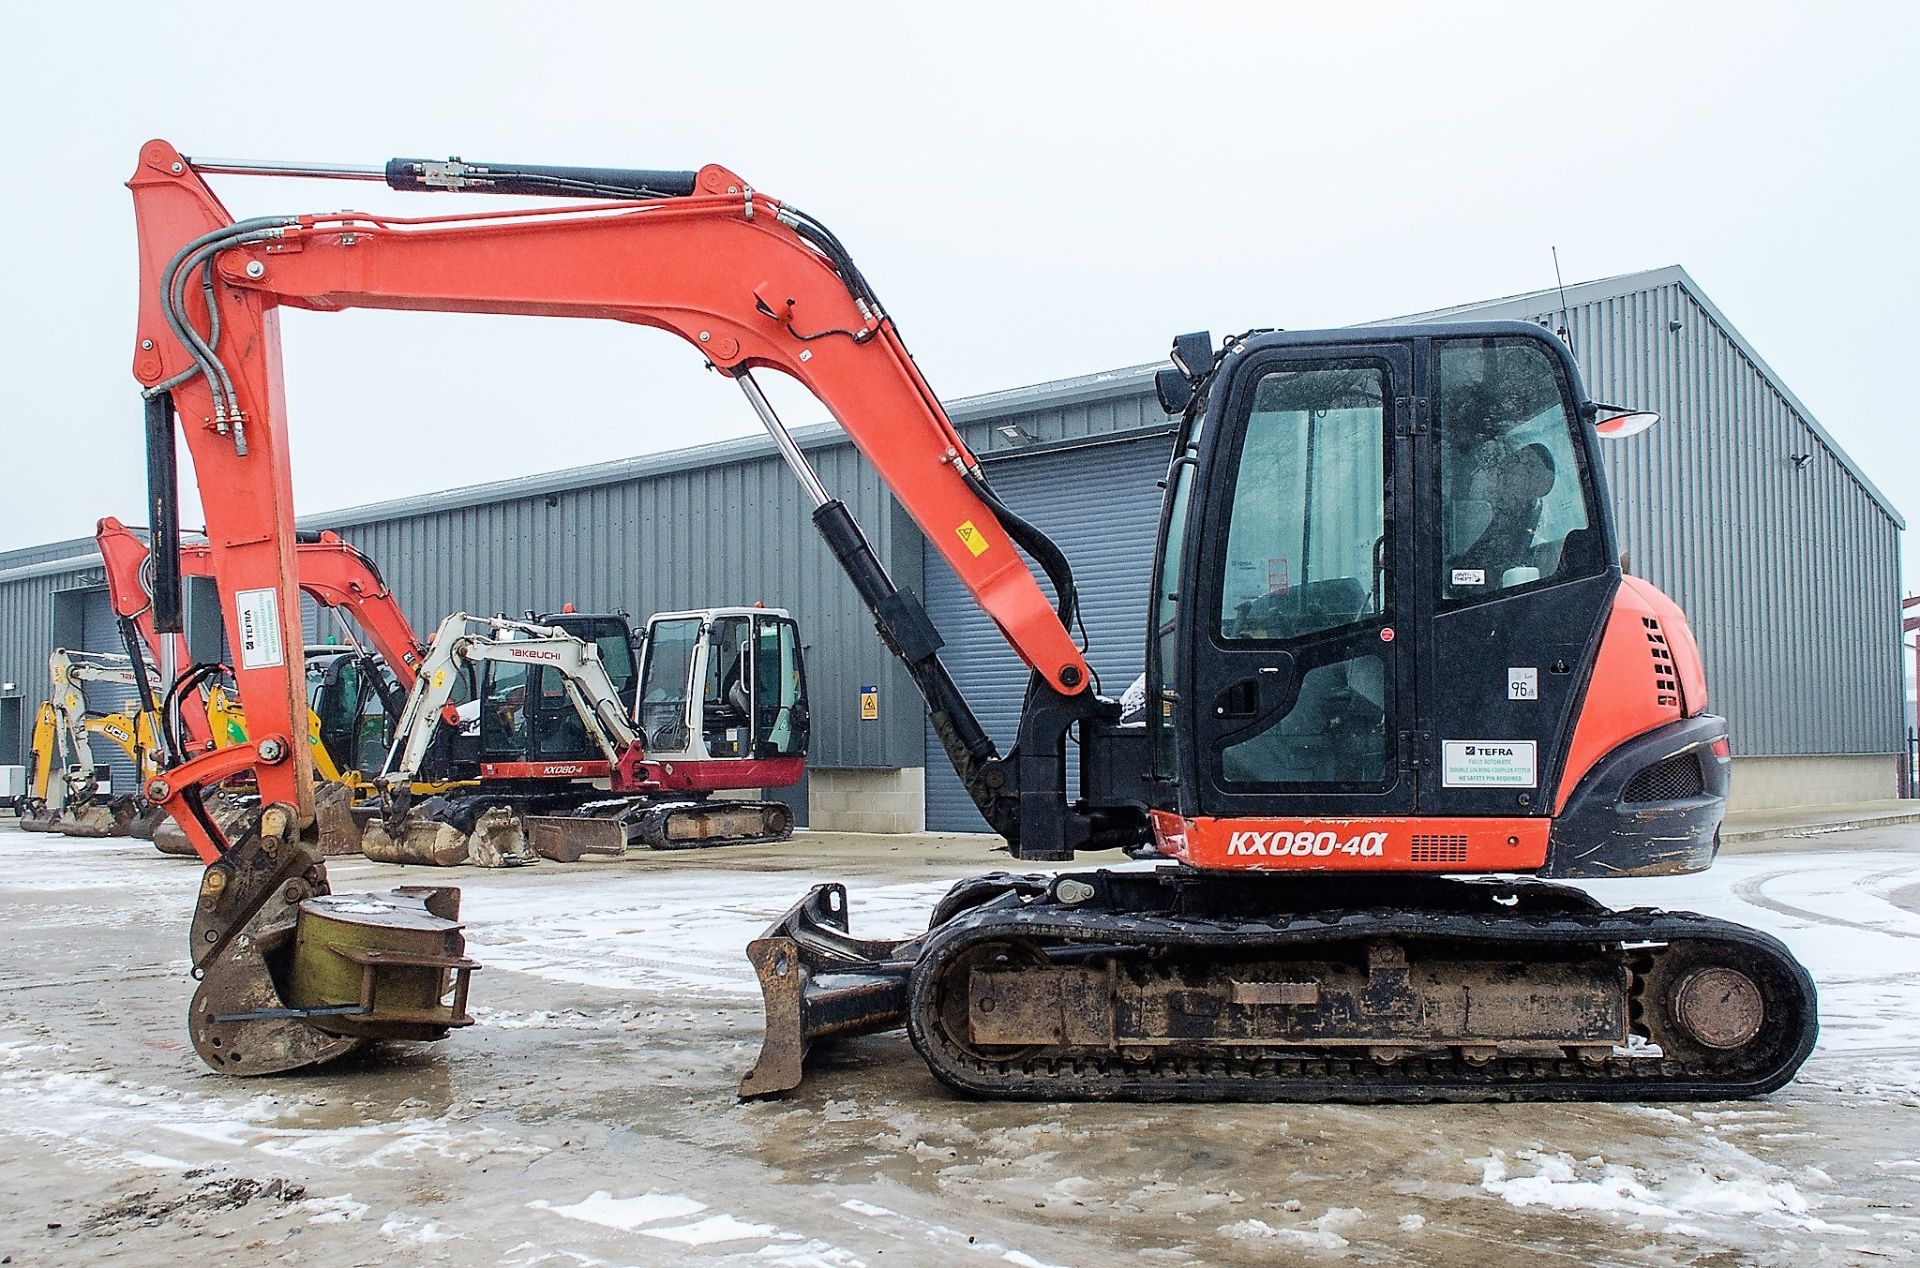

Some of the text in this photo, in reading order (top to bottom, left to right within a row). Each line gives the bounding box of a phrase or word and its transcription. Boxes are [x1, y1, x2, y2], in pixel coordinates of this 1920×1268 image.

[245, 609, 253, 640] TEFRA
[1511, 681, 1527, 697] 96
[105, 724, 129, 741] JCB
[1477, 748, 1513, 756] TEFRA
